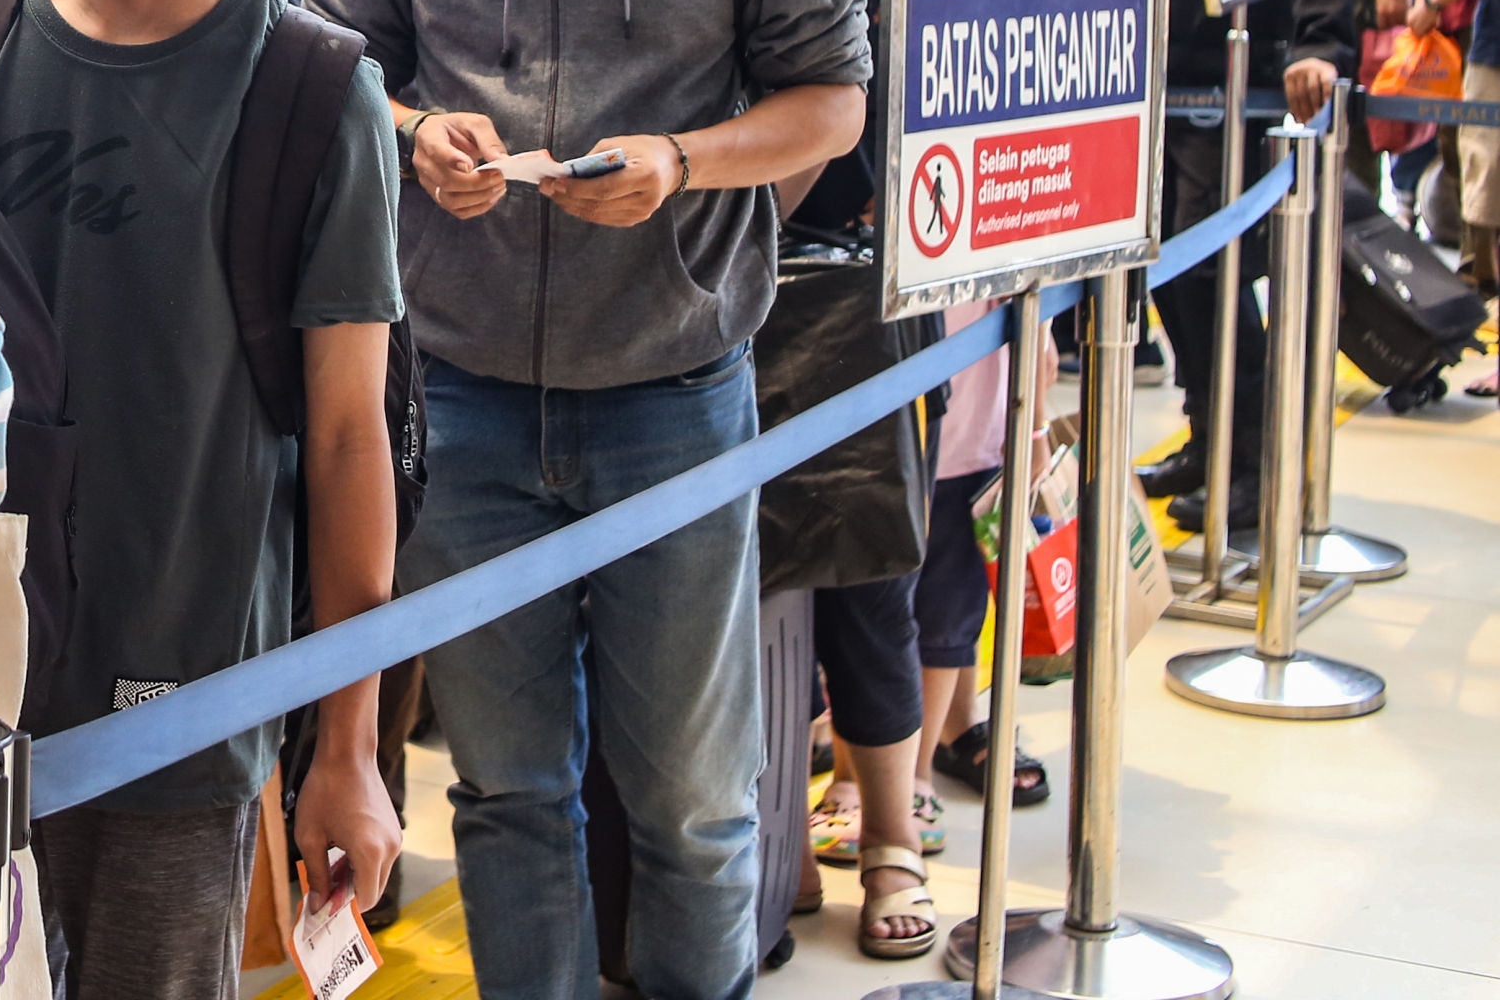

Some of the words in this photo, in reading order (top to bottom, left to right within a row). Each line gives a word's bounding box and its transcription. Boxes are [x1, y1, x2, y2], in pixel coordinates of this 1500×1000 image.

[921, 17, 1000, 118] BATAS
[1005, 8, 1137, 109] PENGANTAR
[979, 146, 1019, 175] Selain
[1019, 143, 1071, 174] petugas
[978, 177, 1030, 206] dilarang
[1031, 165, 1073, 196] masuk
[1062, 199, 1080, 221] only
